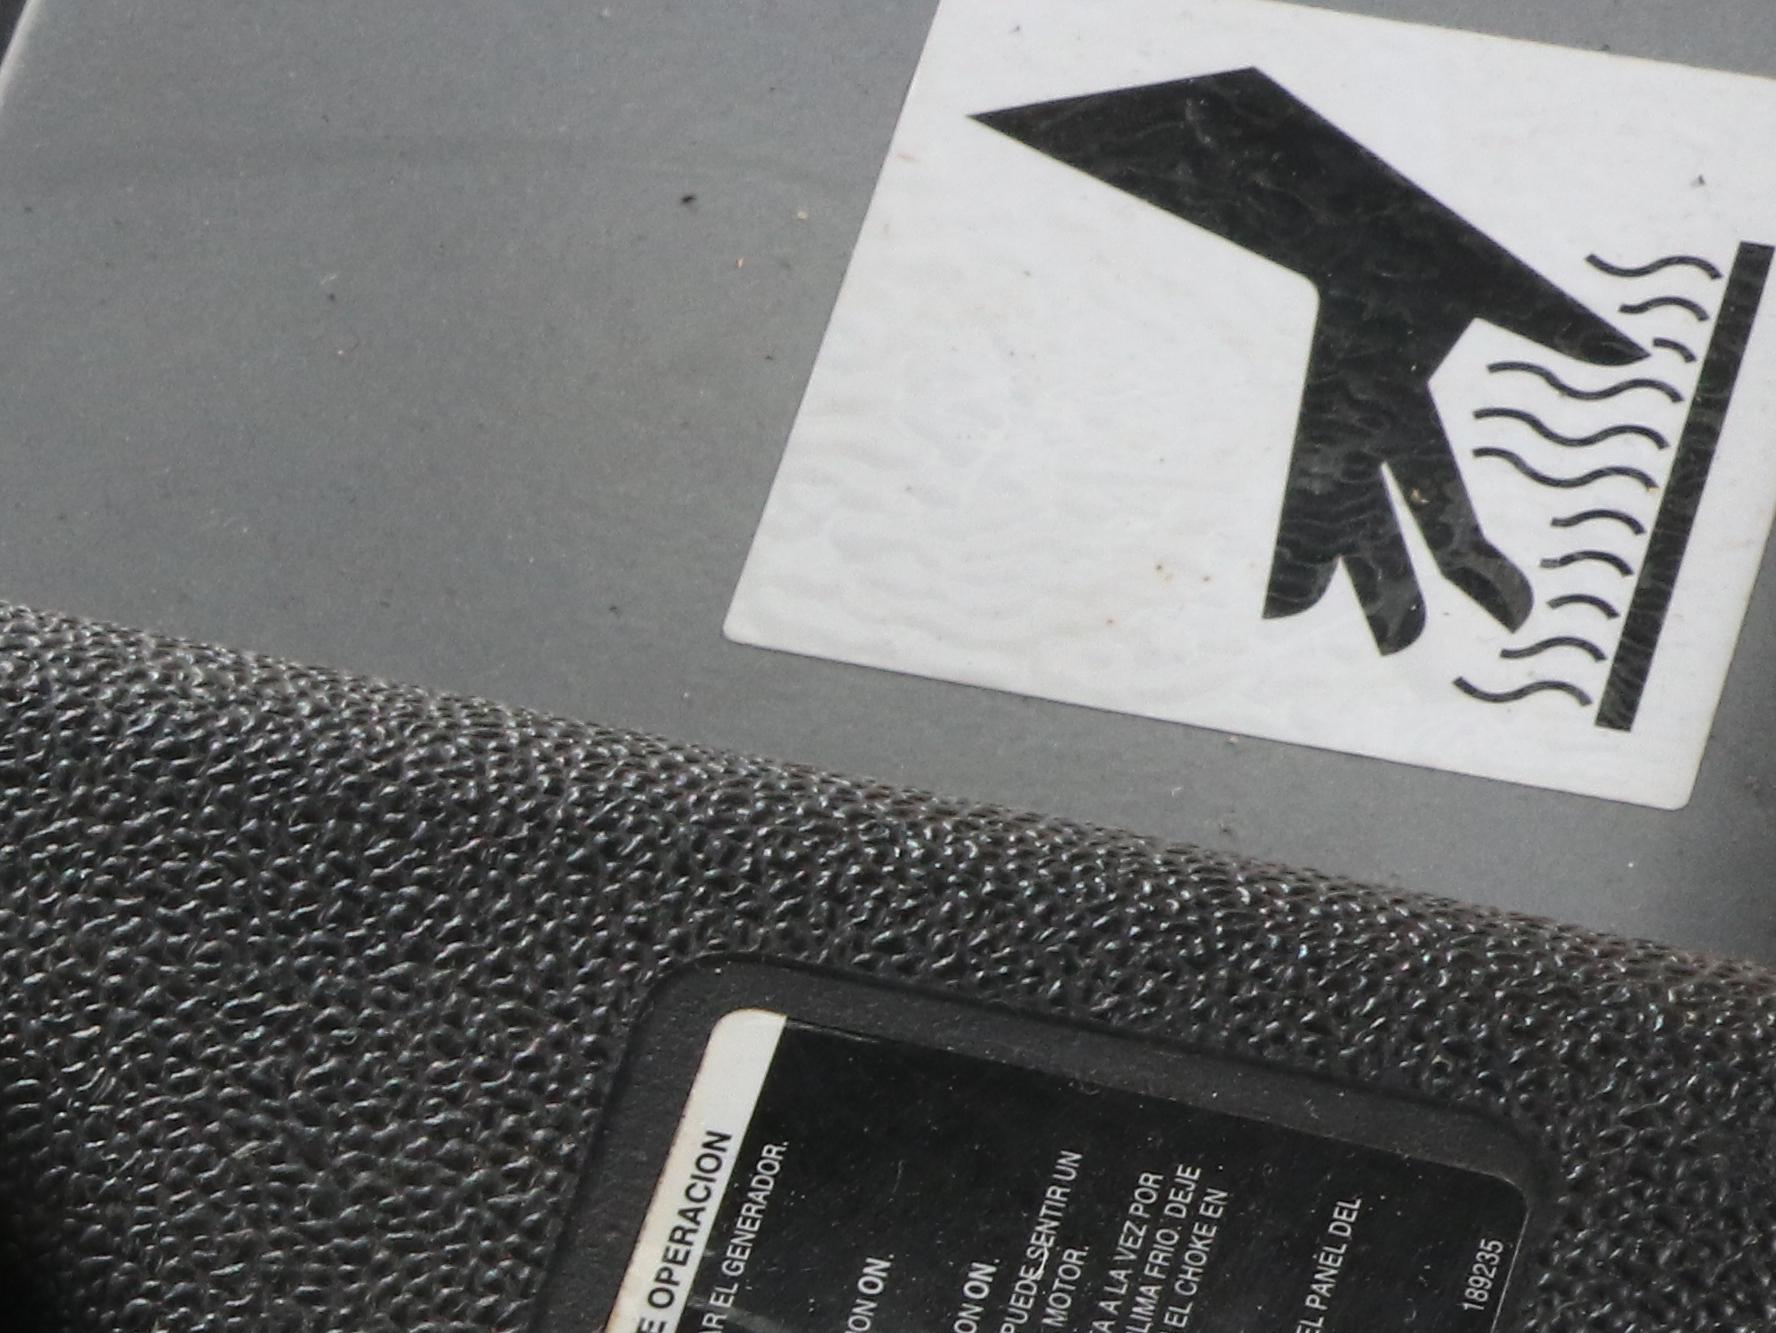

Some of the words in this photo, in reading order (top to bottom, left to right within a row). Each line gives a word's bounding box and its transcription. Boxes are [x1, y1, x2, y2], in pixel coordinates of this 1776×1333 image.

[646, 1130, 732, 1309] OPERACION
[720, 1141, 788, 1276] GENERADOR.
[707, 1282, 738, 1309] EL
[1461, 1238, 1503, 1310] 189235
